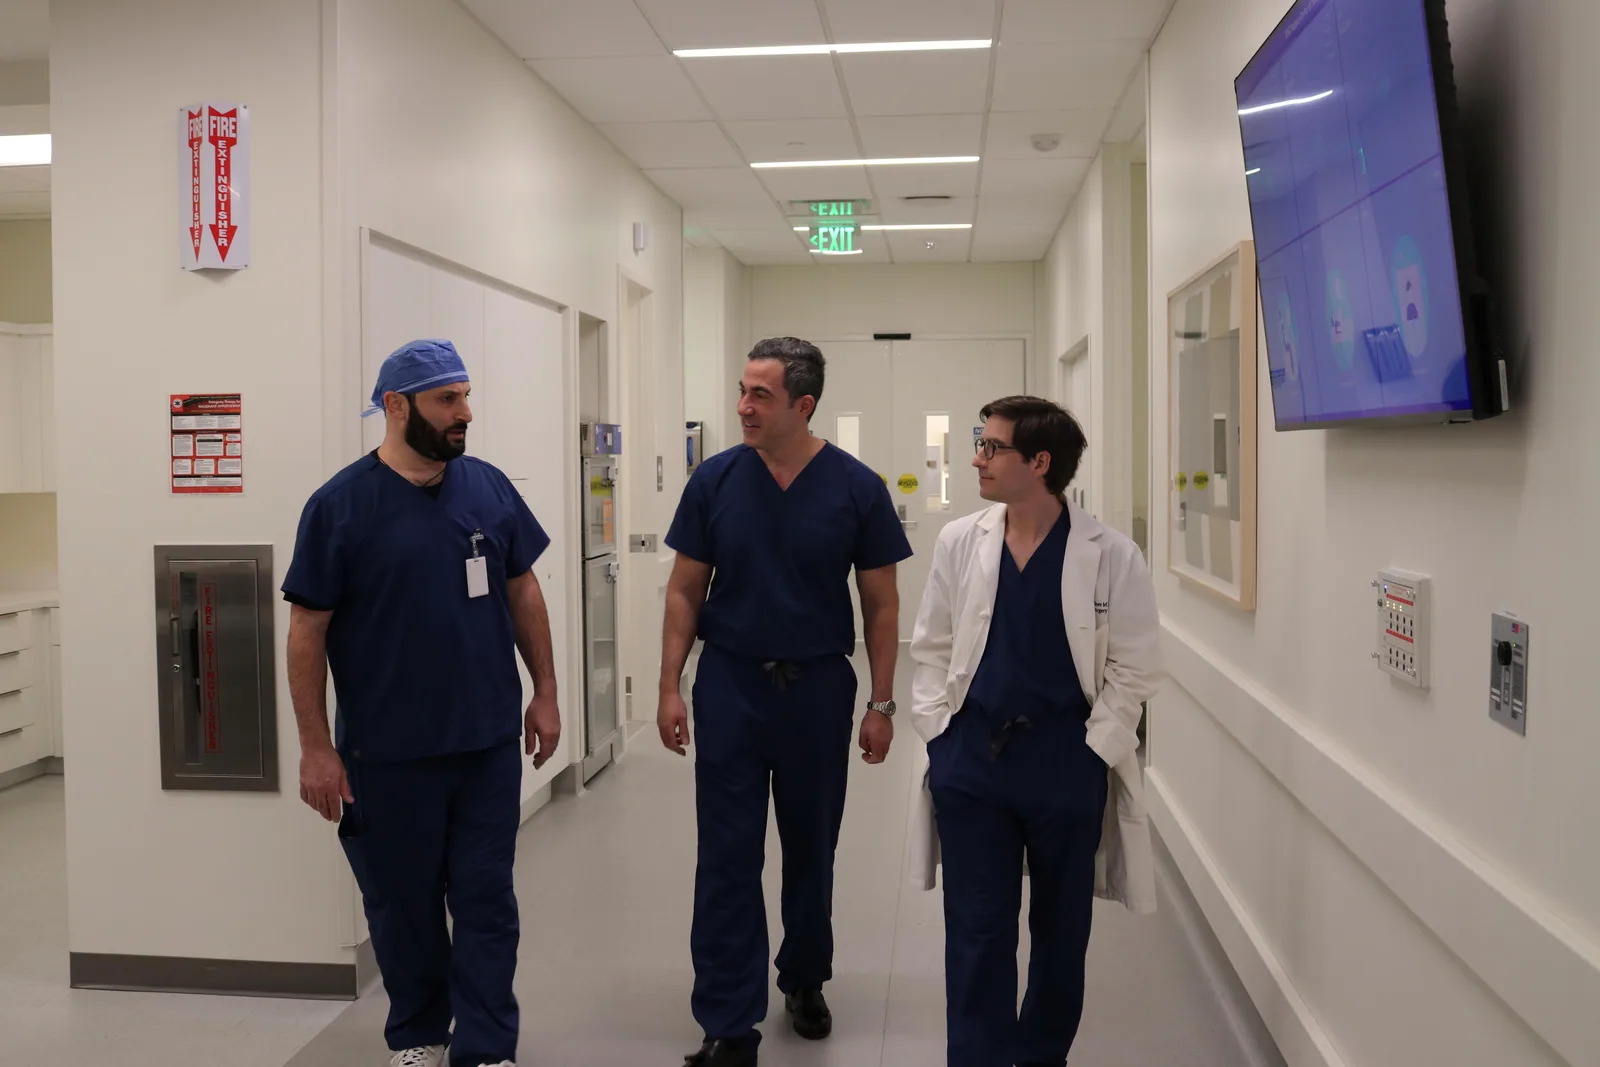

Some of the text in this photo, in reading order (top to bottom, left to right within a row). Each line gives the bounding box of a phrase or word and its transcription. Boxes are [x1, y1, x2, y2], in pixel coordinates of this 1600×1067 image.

[189, 116, 202, 140] FIRE
[209, 115, 237, 138] FIRE
[217, 140, 228, 247] EXTINGUISHER
[818, 226, 854, 252] EXIT
[204, 587, 212, 626] FIRE
[206, 631, 216, 749] EXTINGUISHER
